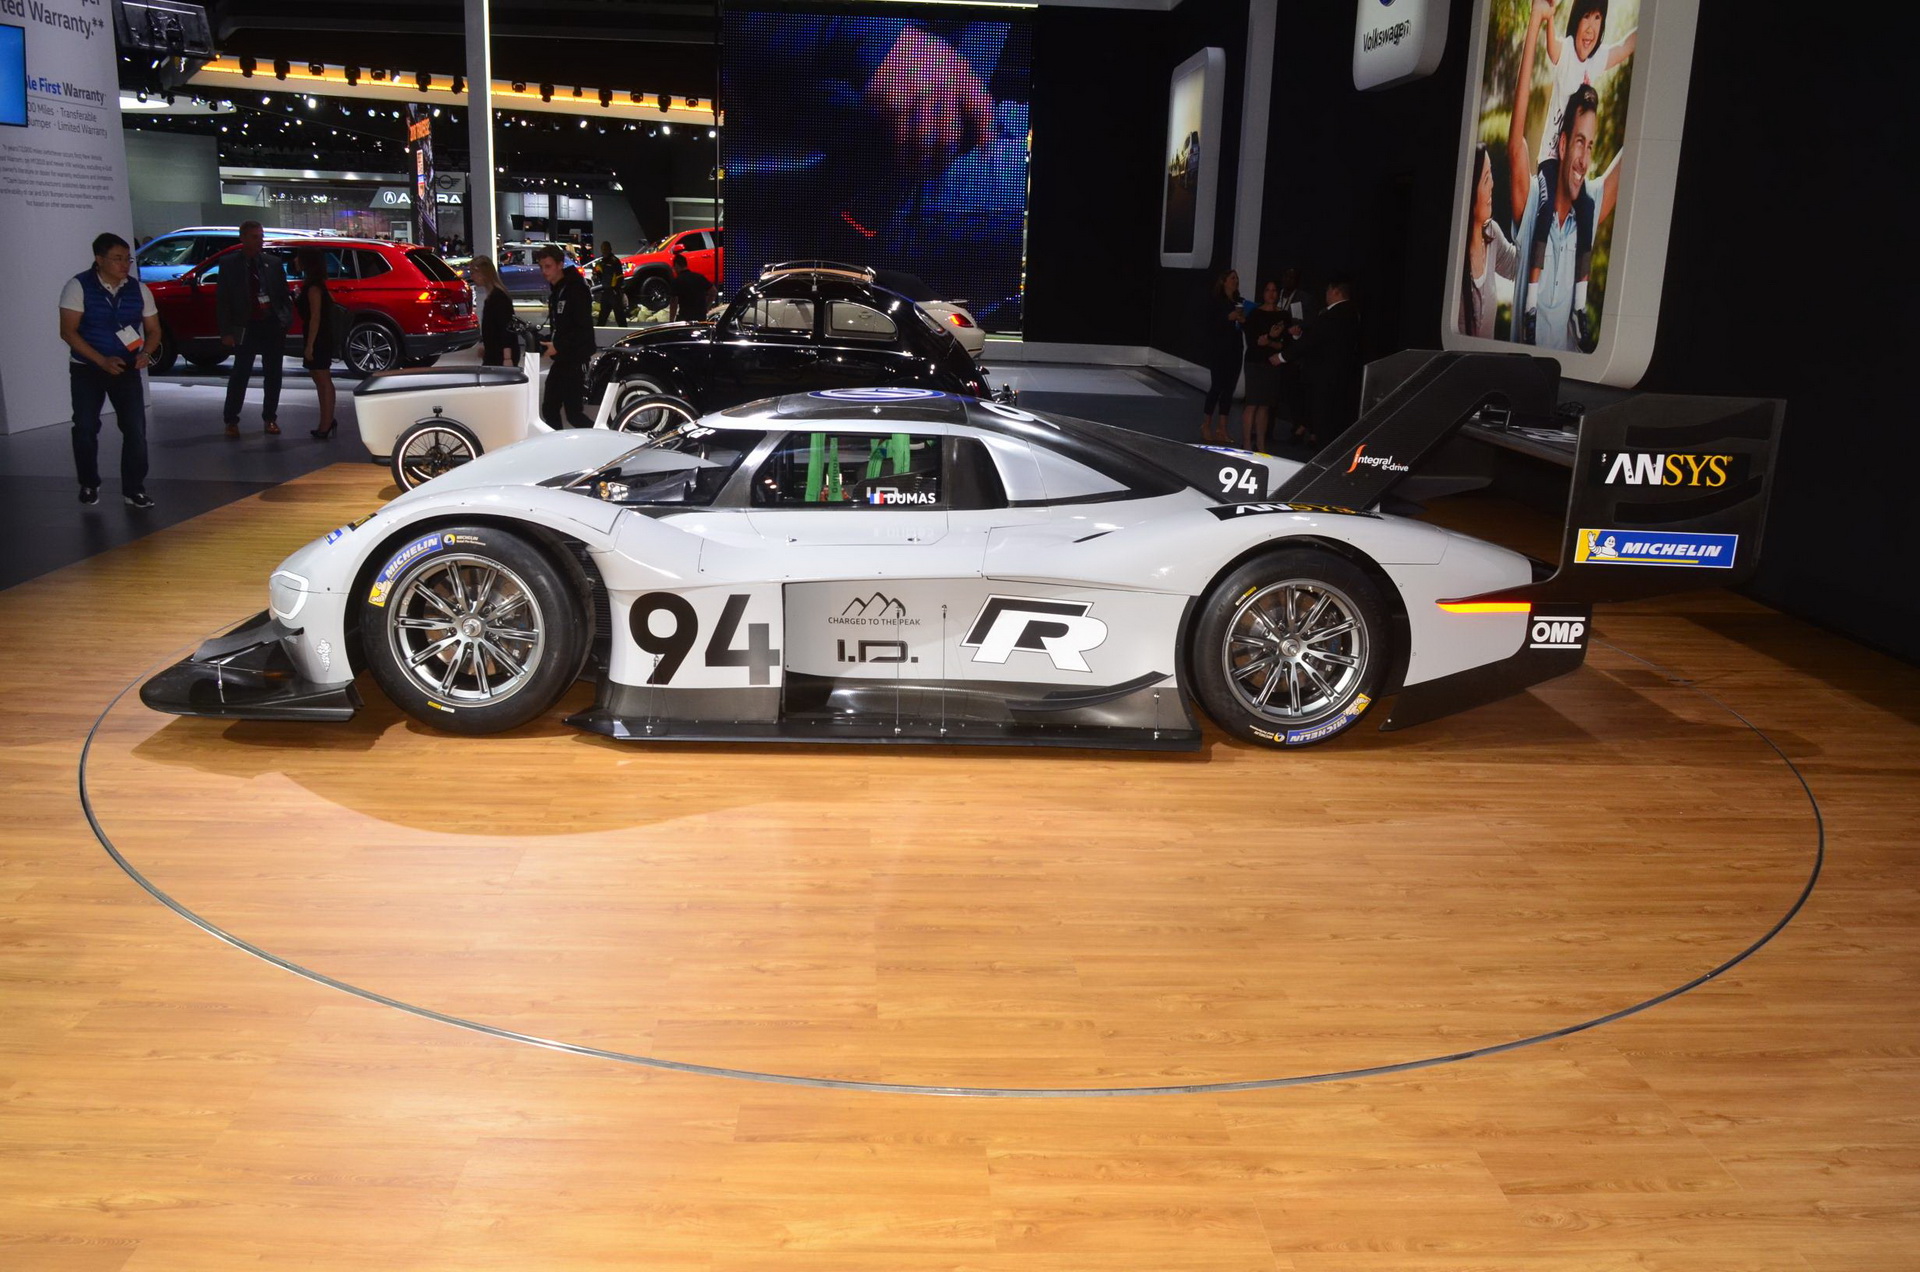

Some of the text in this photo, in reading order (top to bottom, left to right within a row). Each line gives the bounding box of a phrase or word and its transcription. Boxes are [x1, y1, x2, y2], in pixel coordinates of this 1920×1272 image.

[1363, 19, 1411, 52] Volkswagen
[39, 78, 62, 95] First
[38, 104, 55, 116] Miles
[60, 107, 97, 122] Transferable
[58, 120, 81, 133] Limited
[82, 123, 107, 138] Warranty
[397, 192, 462, 204] ARA
[1382, 464, 1409, 472] e-drive
[1218, 466, 1258, 495] 94
[887, 493, 936, 504] DUMAS
[385, 537, 439, 578] MICHELIN
[1621, 542, 1722, 557] MICHELIN
[828, 616, 866, 625] CHARGED
[882, 618, 897, 626] THE
[629, 591, 780, 685] 94
[1532, 622, 1584, 643] OMP
[837, 639, 919, 663] I.D.
[1289, 716, 1347, 742] MICHELIN
